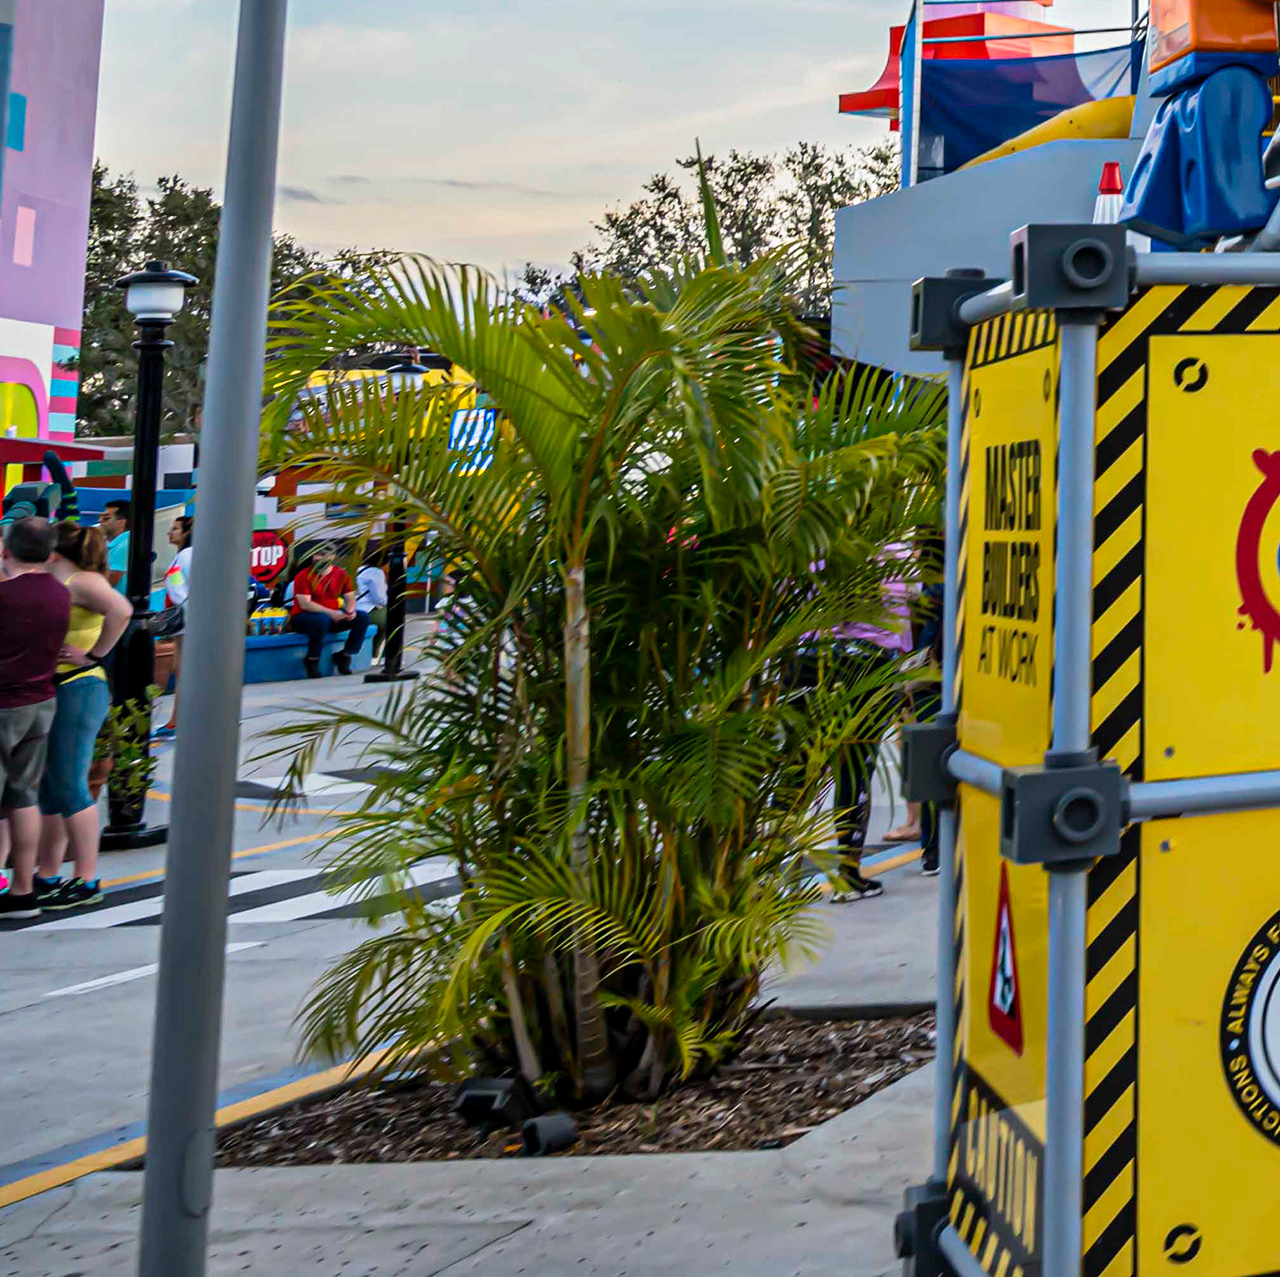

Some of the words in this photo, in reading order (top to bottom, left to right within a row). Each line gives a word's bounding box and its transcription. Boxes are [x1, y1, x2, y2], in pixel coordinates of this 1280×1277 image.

[984, 438, 1042, 531] MASTER
[250, 544, 284, 567] TOP
[977, 624, 996, 675] AT
[998, 628, 1039, 688] WORK
[1226, 944, 1272, 1036] ALWAYS
